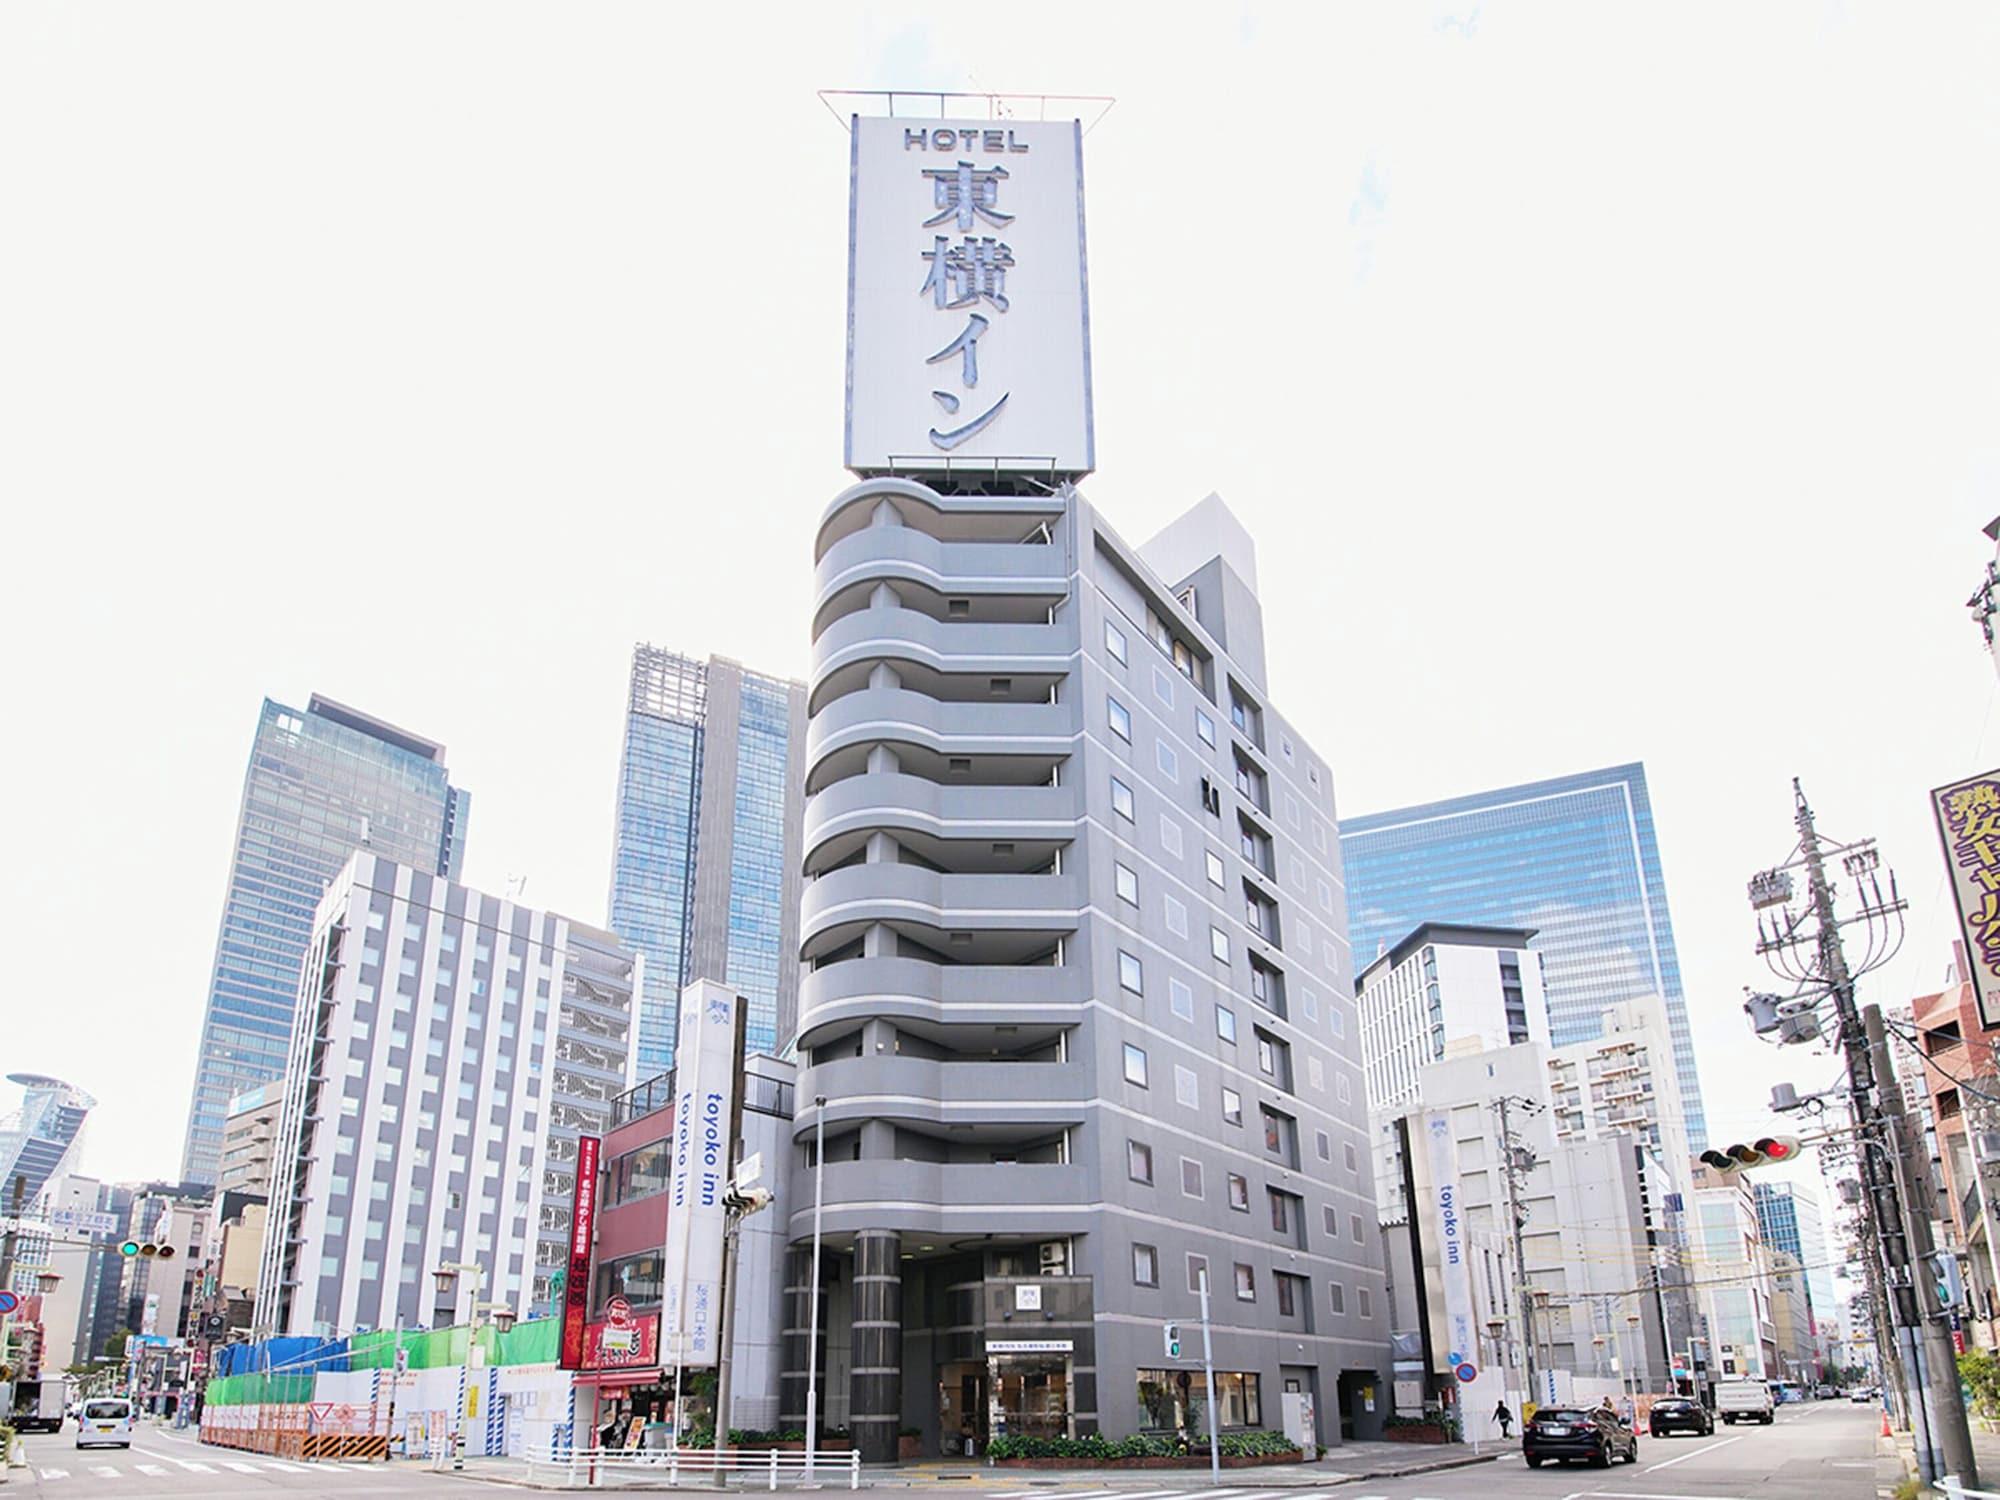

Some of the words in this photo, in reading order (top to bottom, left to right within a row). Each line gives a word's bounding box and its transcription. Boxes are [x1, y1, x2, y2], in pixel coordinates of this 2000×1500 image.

[905, 128, 1029, 153] HOTEL
[919, 160, 1016, 452] 東横イン
[677, 1092, 692, 1166] toyoko
[703, 1092, 723, 1167] toyoko
[675, 1172, 688, 1207] inn
[701, 1172, 720, 1207] inn
[1440, 1184, 1457, 1237] toyoko
[1447, 1241, 1460, 1266] inn
